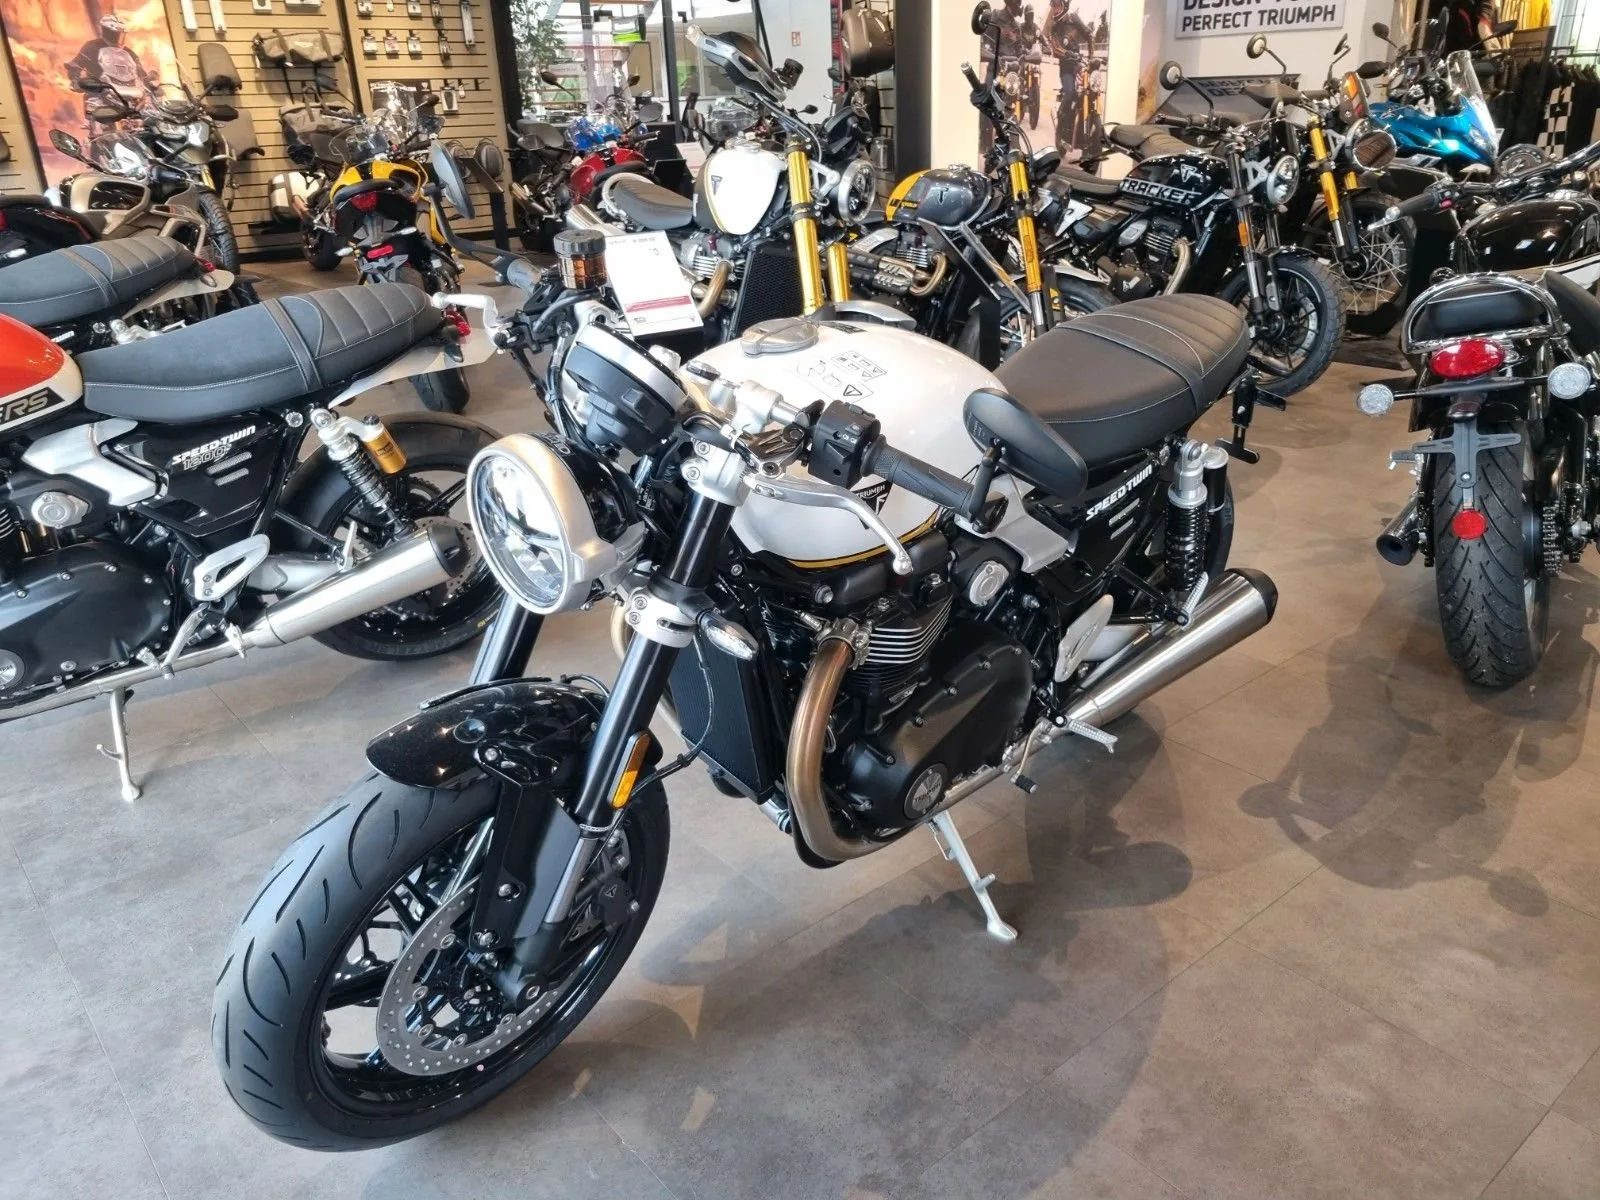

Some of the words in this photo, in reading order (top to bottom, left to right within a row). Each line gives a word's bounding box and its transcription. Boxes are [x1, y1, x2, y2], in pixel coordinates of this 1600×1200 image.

[1182, 11, 1252, 32] PERFECT
[1258, 4, 1336, 26] TRIUMPH
[171, 439, 220, 465] SPEED
[220, 425, 256, 445] TWIN
[1085, 485, 1127, 521] SPEED
[1126, 464, 1152, 491] TWIN
